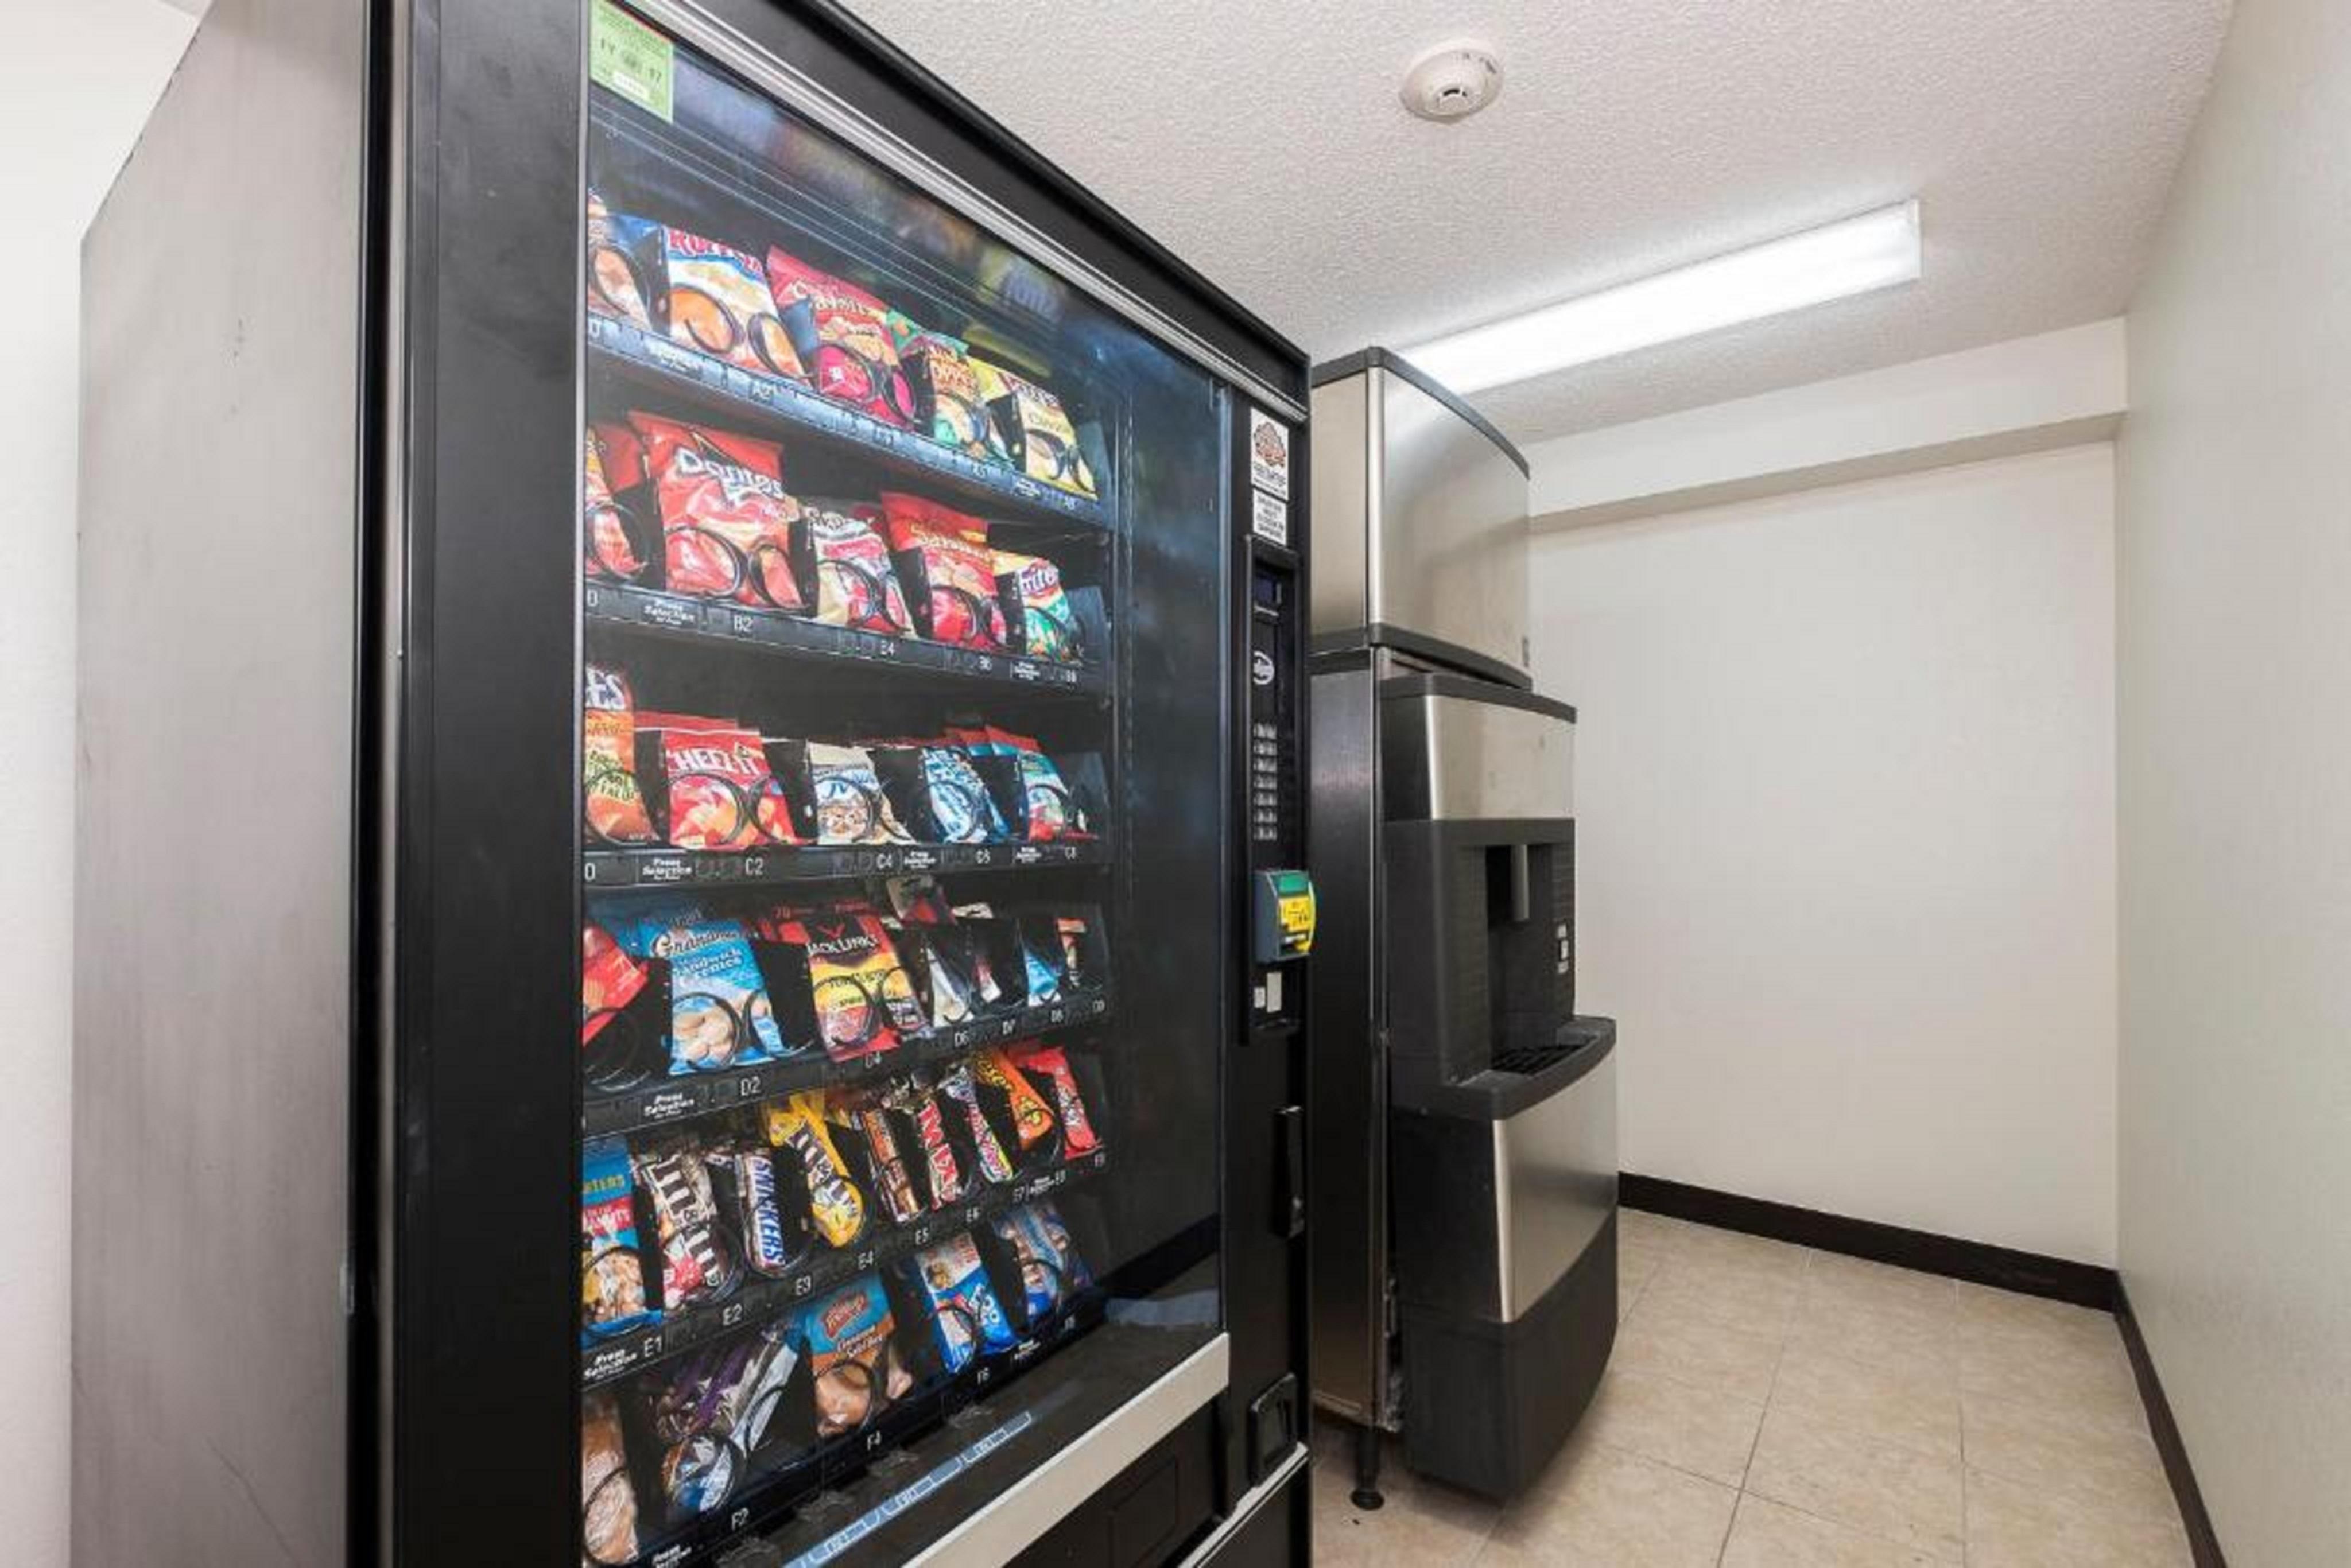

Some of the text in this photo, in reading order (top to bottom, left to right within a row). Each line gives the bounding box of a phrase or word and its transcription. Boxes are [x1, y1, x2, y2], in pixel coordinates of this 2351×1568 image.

[735, 616, 753, 631] B2
[746, 858, 763, 875] C2
[741, 1076, 761, 1096] D2
[751, 1156, 786, 1266] SNICKERS
[859, 1252, 874, 1270] E4
[796, 1276, 812, 1296] E3
[723, 1304, 743, 1325] E2
[643, 1338, 662, 1358] E1
[867, 1431, 882, 1450] F4
[732, 1507, 749, 1531] F2
